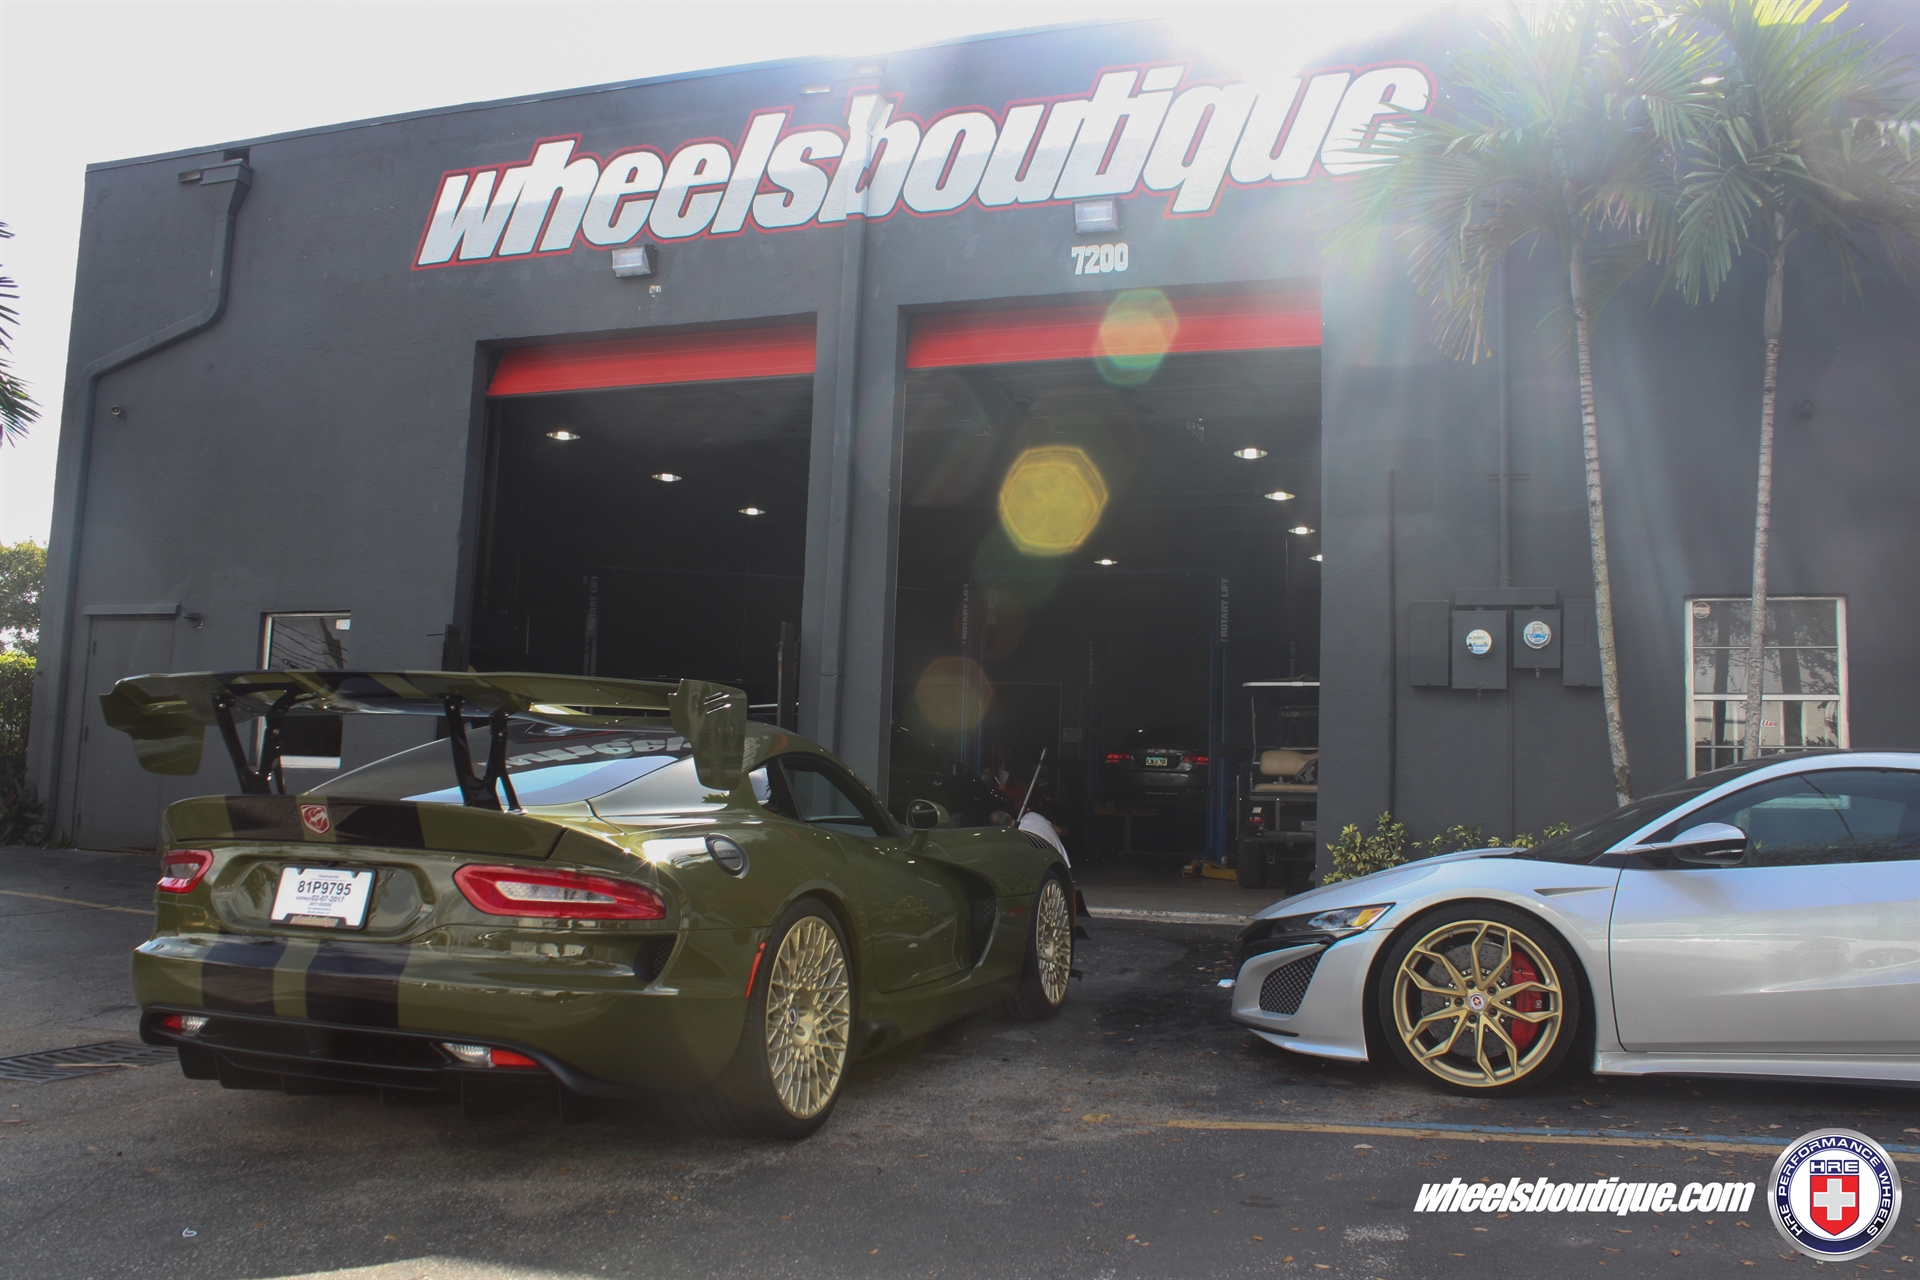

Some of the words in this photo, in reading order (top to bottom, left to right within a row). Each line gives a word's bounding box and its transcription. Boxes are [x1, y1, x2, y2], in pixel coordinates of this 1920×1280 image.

[415, 62, 1430, 267] wheelsboutique
[1071, 243, 1129, 275] 7200
[1221, 578, 1229, 598] LIFT
[588, 595, 597, 630] ROTARY
[1220, 599, 1229, 637] ROTARY
[297, 880, 352, 896] 81P9795
[311, 894, 345, 904] 02-07-2017
